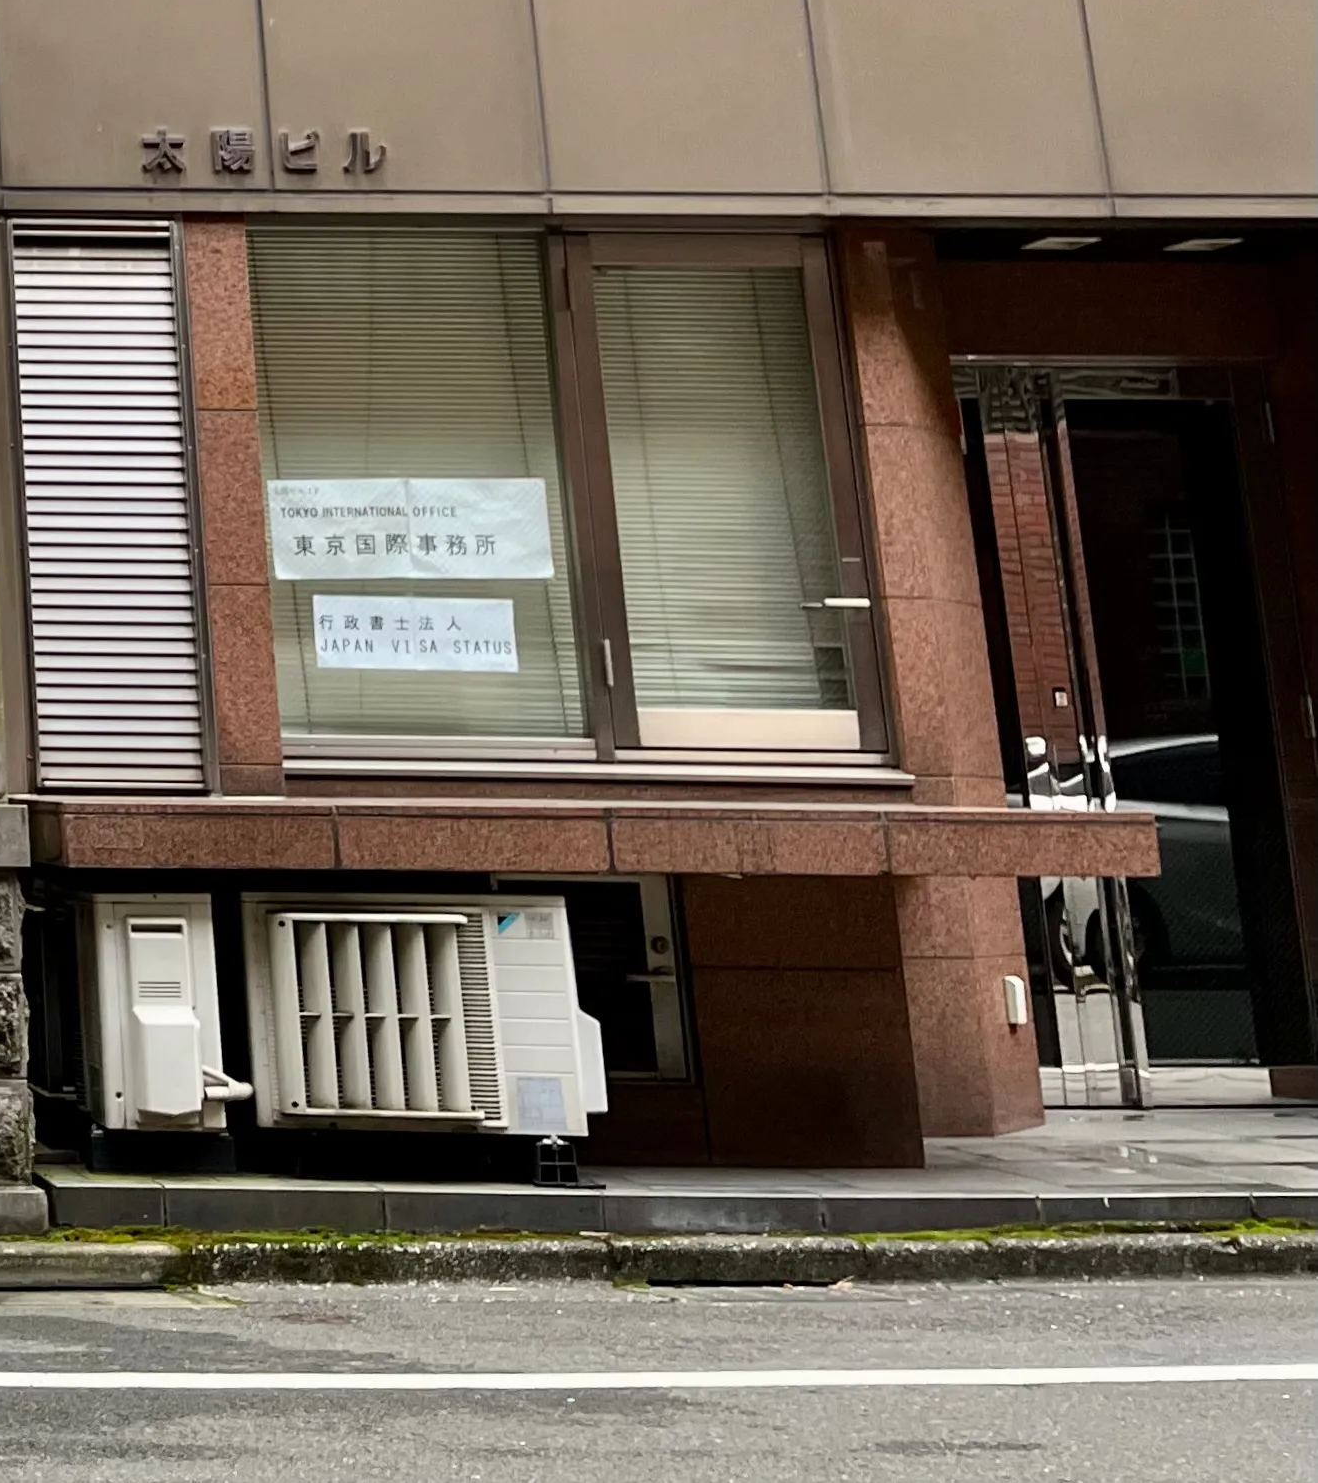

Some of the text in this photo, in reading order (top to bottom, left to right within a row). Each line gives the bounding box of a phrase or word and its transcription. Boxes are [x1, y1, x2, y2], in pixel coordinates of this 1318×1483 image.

[141, 126, 387, 173] 太陽ビル
[280, 506, 457, 519] TOKYO INTERNATIONAL OFFICE
[293, 533, 496, 557] 東京国際事務所
[319, 615, 462, 632] 行政書士法人
[320, 637, 513, 656] JAPAN VISA STATUS
